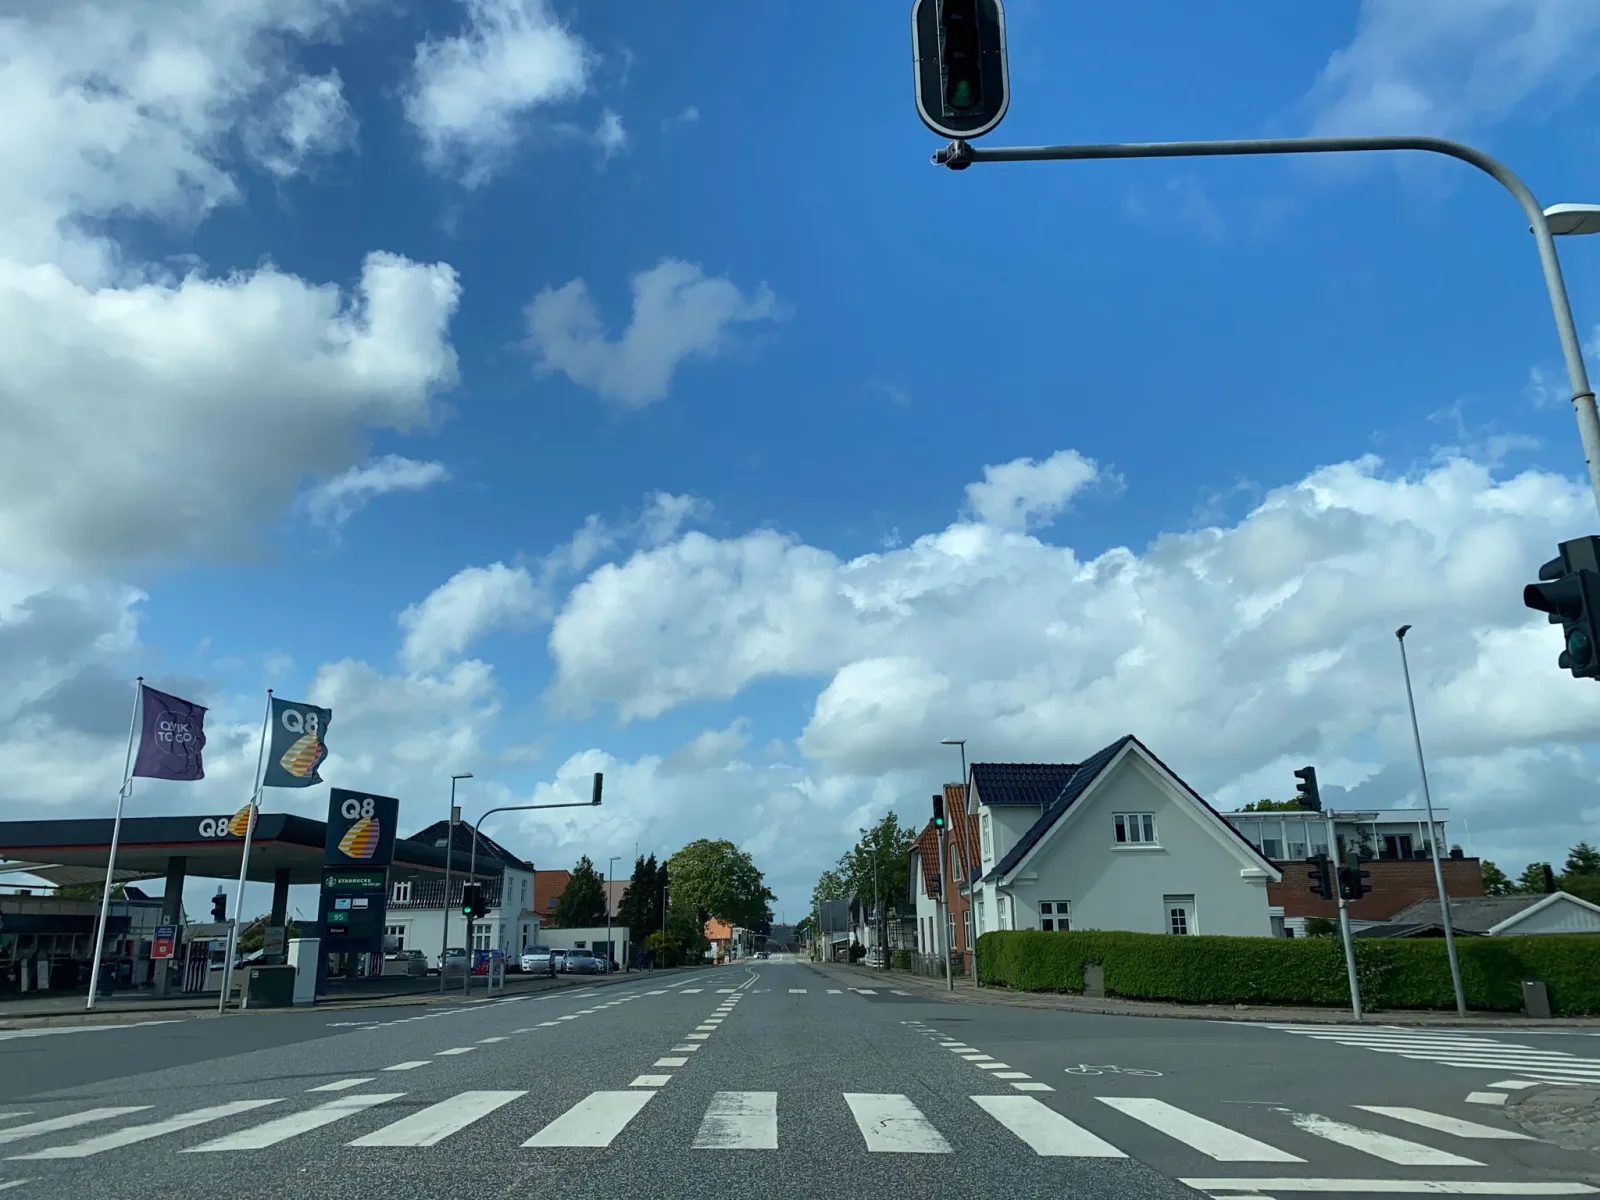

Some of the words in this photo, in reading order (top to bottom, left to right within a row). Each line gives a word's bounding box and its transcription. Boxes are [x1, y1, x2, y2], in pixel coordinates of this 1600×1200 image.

[160, 721, 189, 732] QVIK
[282, 709, 318, 733] Q8
[175, 733, 192, 743] GO
[341, 798, 375, 819] Q8
[199, 818, 229, 837] Q8
